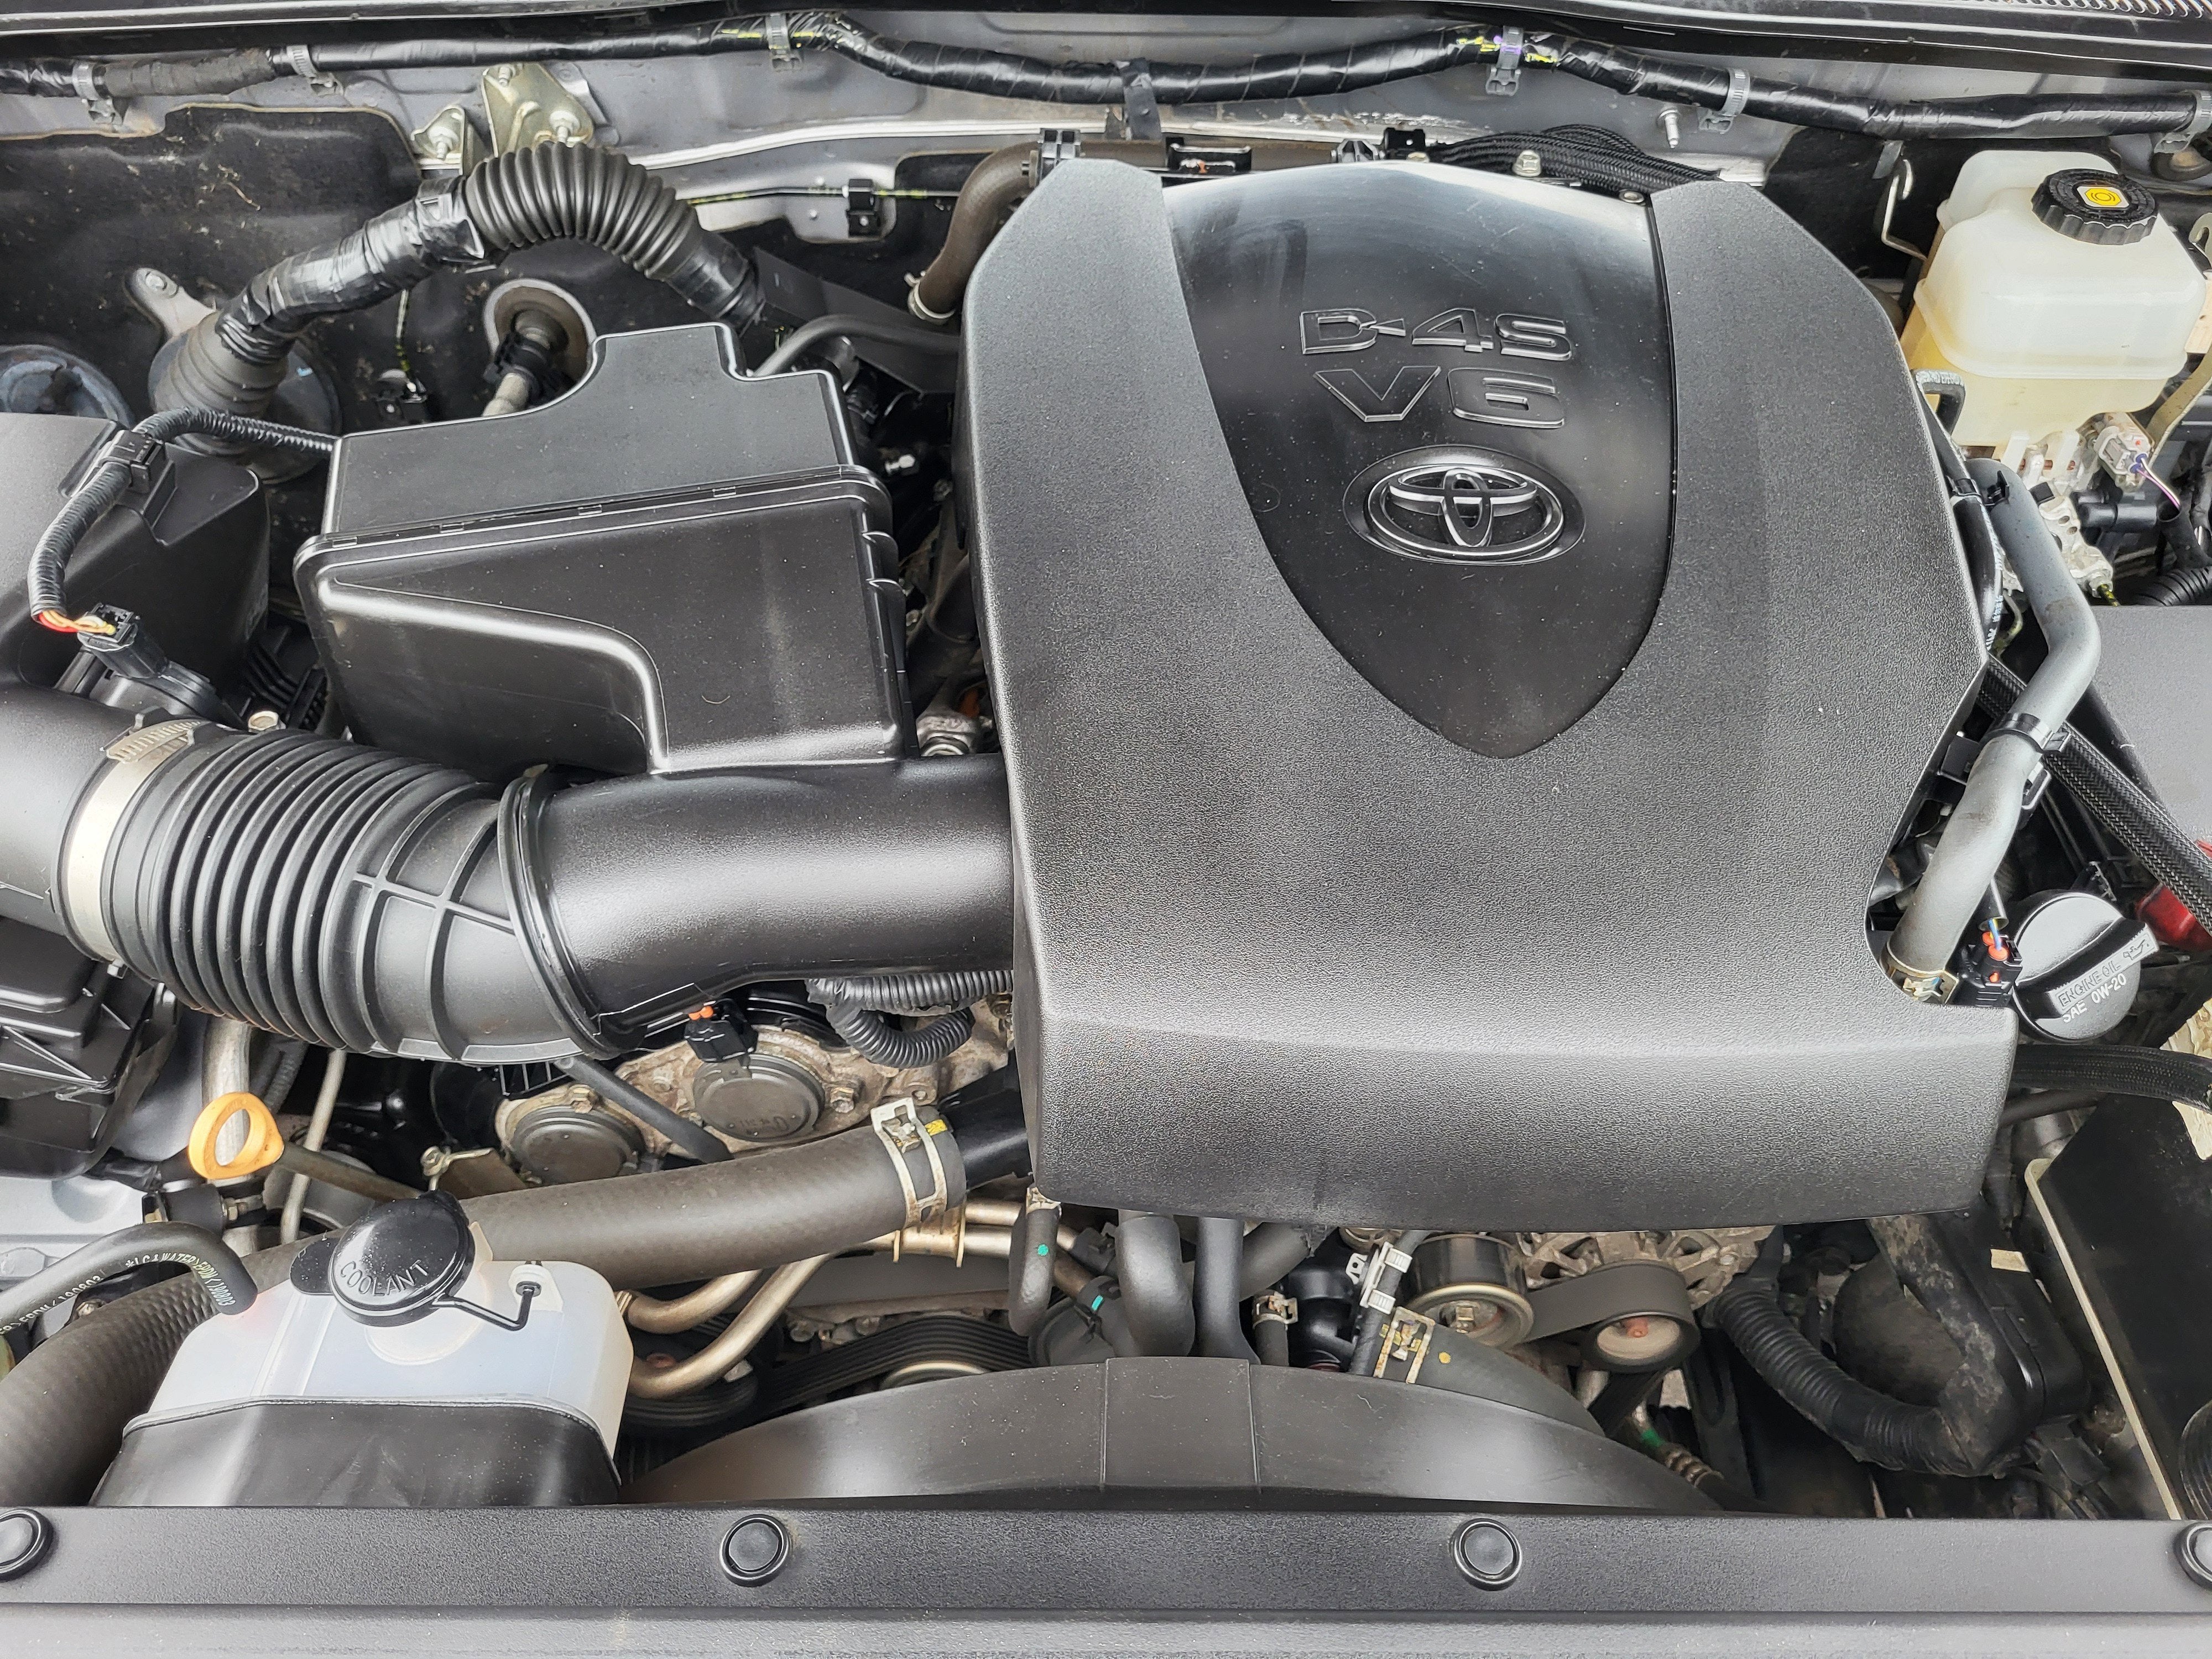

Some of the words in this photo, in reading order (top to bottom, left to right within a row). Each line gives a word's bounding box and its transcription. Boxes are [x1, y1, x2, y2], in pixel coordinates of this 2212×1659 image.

[1300, 307, 1572, 361] D-4S
[1313, 366, 1565, 429] V6
[2058, 971, 2103, 1008] ENGINE
[2101, 960, 2121, 977] OIL
[2062, 1000, 2088, 1023] SAE
[2091, 973, 2127, 1004] 0W-20
[340, 1259, 429, 1297] COOLANT
